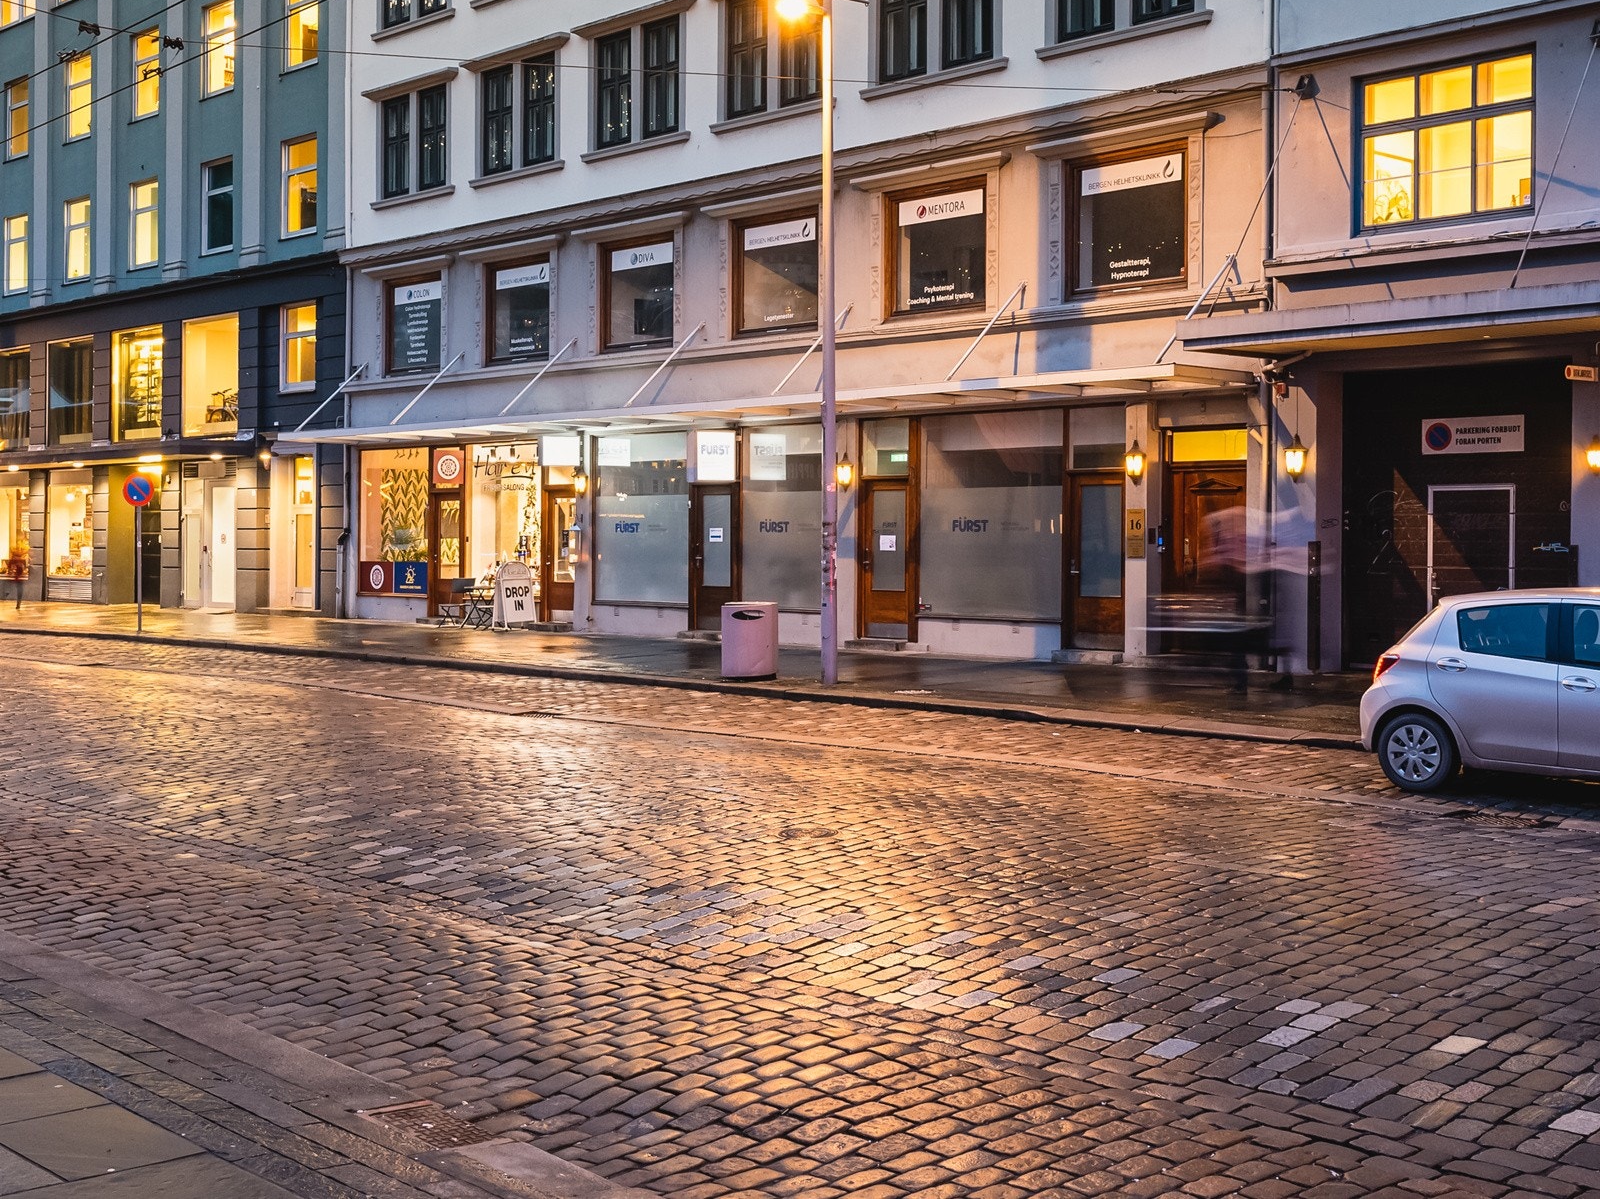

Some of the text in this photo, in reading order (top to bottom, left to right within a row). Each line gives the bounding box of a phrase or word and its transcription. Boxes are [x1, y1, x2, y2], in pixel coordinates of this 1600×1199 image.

[1088, 172, 1161, 191] BERGEN HELHETSKLINIKK
[928, 201, 965, 215] MENTORA
[749, 233, 800, 246] BERGEN HELHETSKLINIKK
[638, 252, 654, 263] DIVA
[1109, 257, 1151, 269] Gestaltterapi,
[1111, 268, 1149, 280] Hypnoterapi
[413, 288, 430, 299] COLON
[924, 283, 955, 294] Psykoterapi
[906, 296, 930, 306] Coaching
[936, 293, 954, 302] Mental
[955, 291, 974, 300] trening
[1455, 425, 1520, 434] PARKERING FORBUDT
[615, 520, 640, 533] FÜRST
[759, 519, 790, 533] FÜRST
[952, 517, 989, 532] FÜRST
[1130, 519, 1142, 530] 16
[505, 586, 530, 598] DROP
[514, 600, 524, 611] IN
